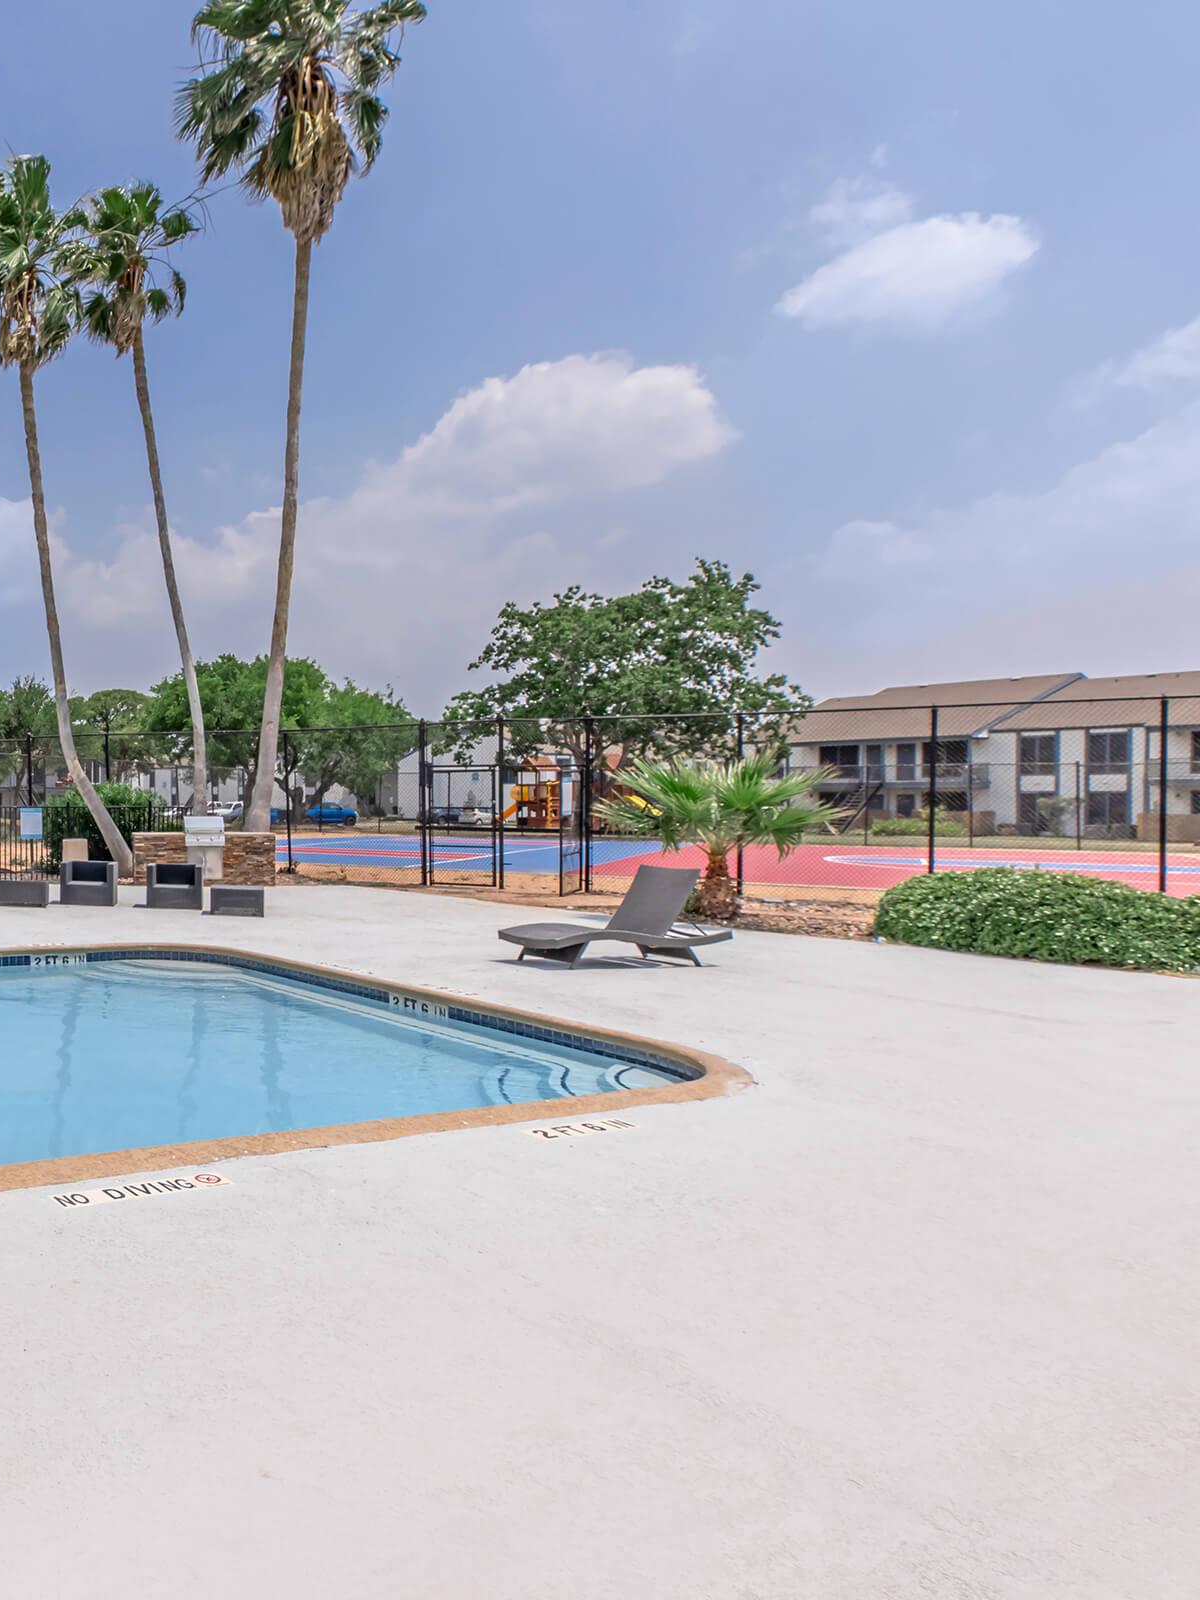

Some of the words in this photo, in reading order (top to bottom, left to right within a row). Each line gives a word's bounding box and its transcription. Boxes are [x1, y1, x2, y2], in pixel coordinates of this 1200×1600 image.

[34, 957, 42, 965] 2
[45, 955, 58, 965] FT
[74, 955, 85, 964] IN
[404, 997, 417, 1010] FT
[434, 1006, 446, 1017] IN
[532, 1129, 559, 1139] 2
[551, 1125, 585, 1136] FT
[582, 1123, 607, 1132] 6
[600, 1119, 636, 1129] IN
[53, 1193, 90, 1207] NO
[102, 1178, 196, 1200] DIVING
